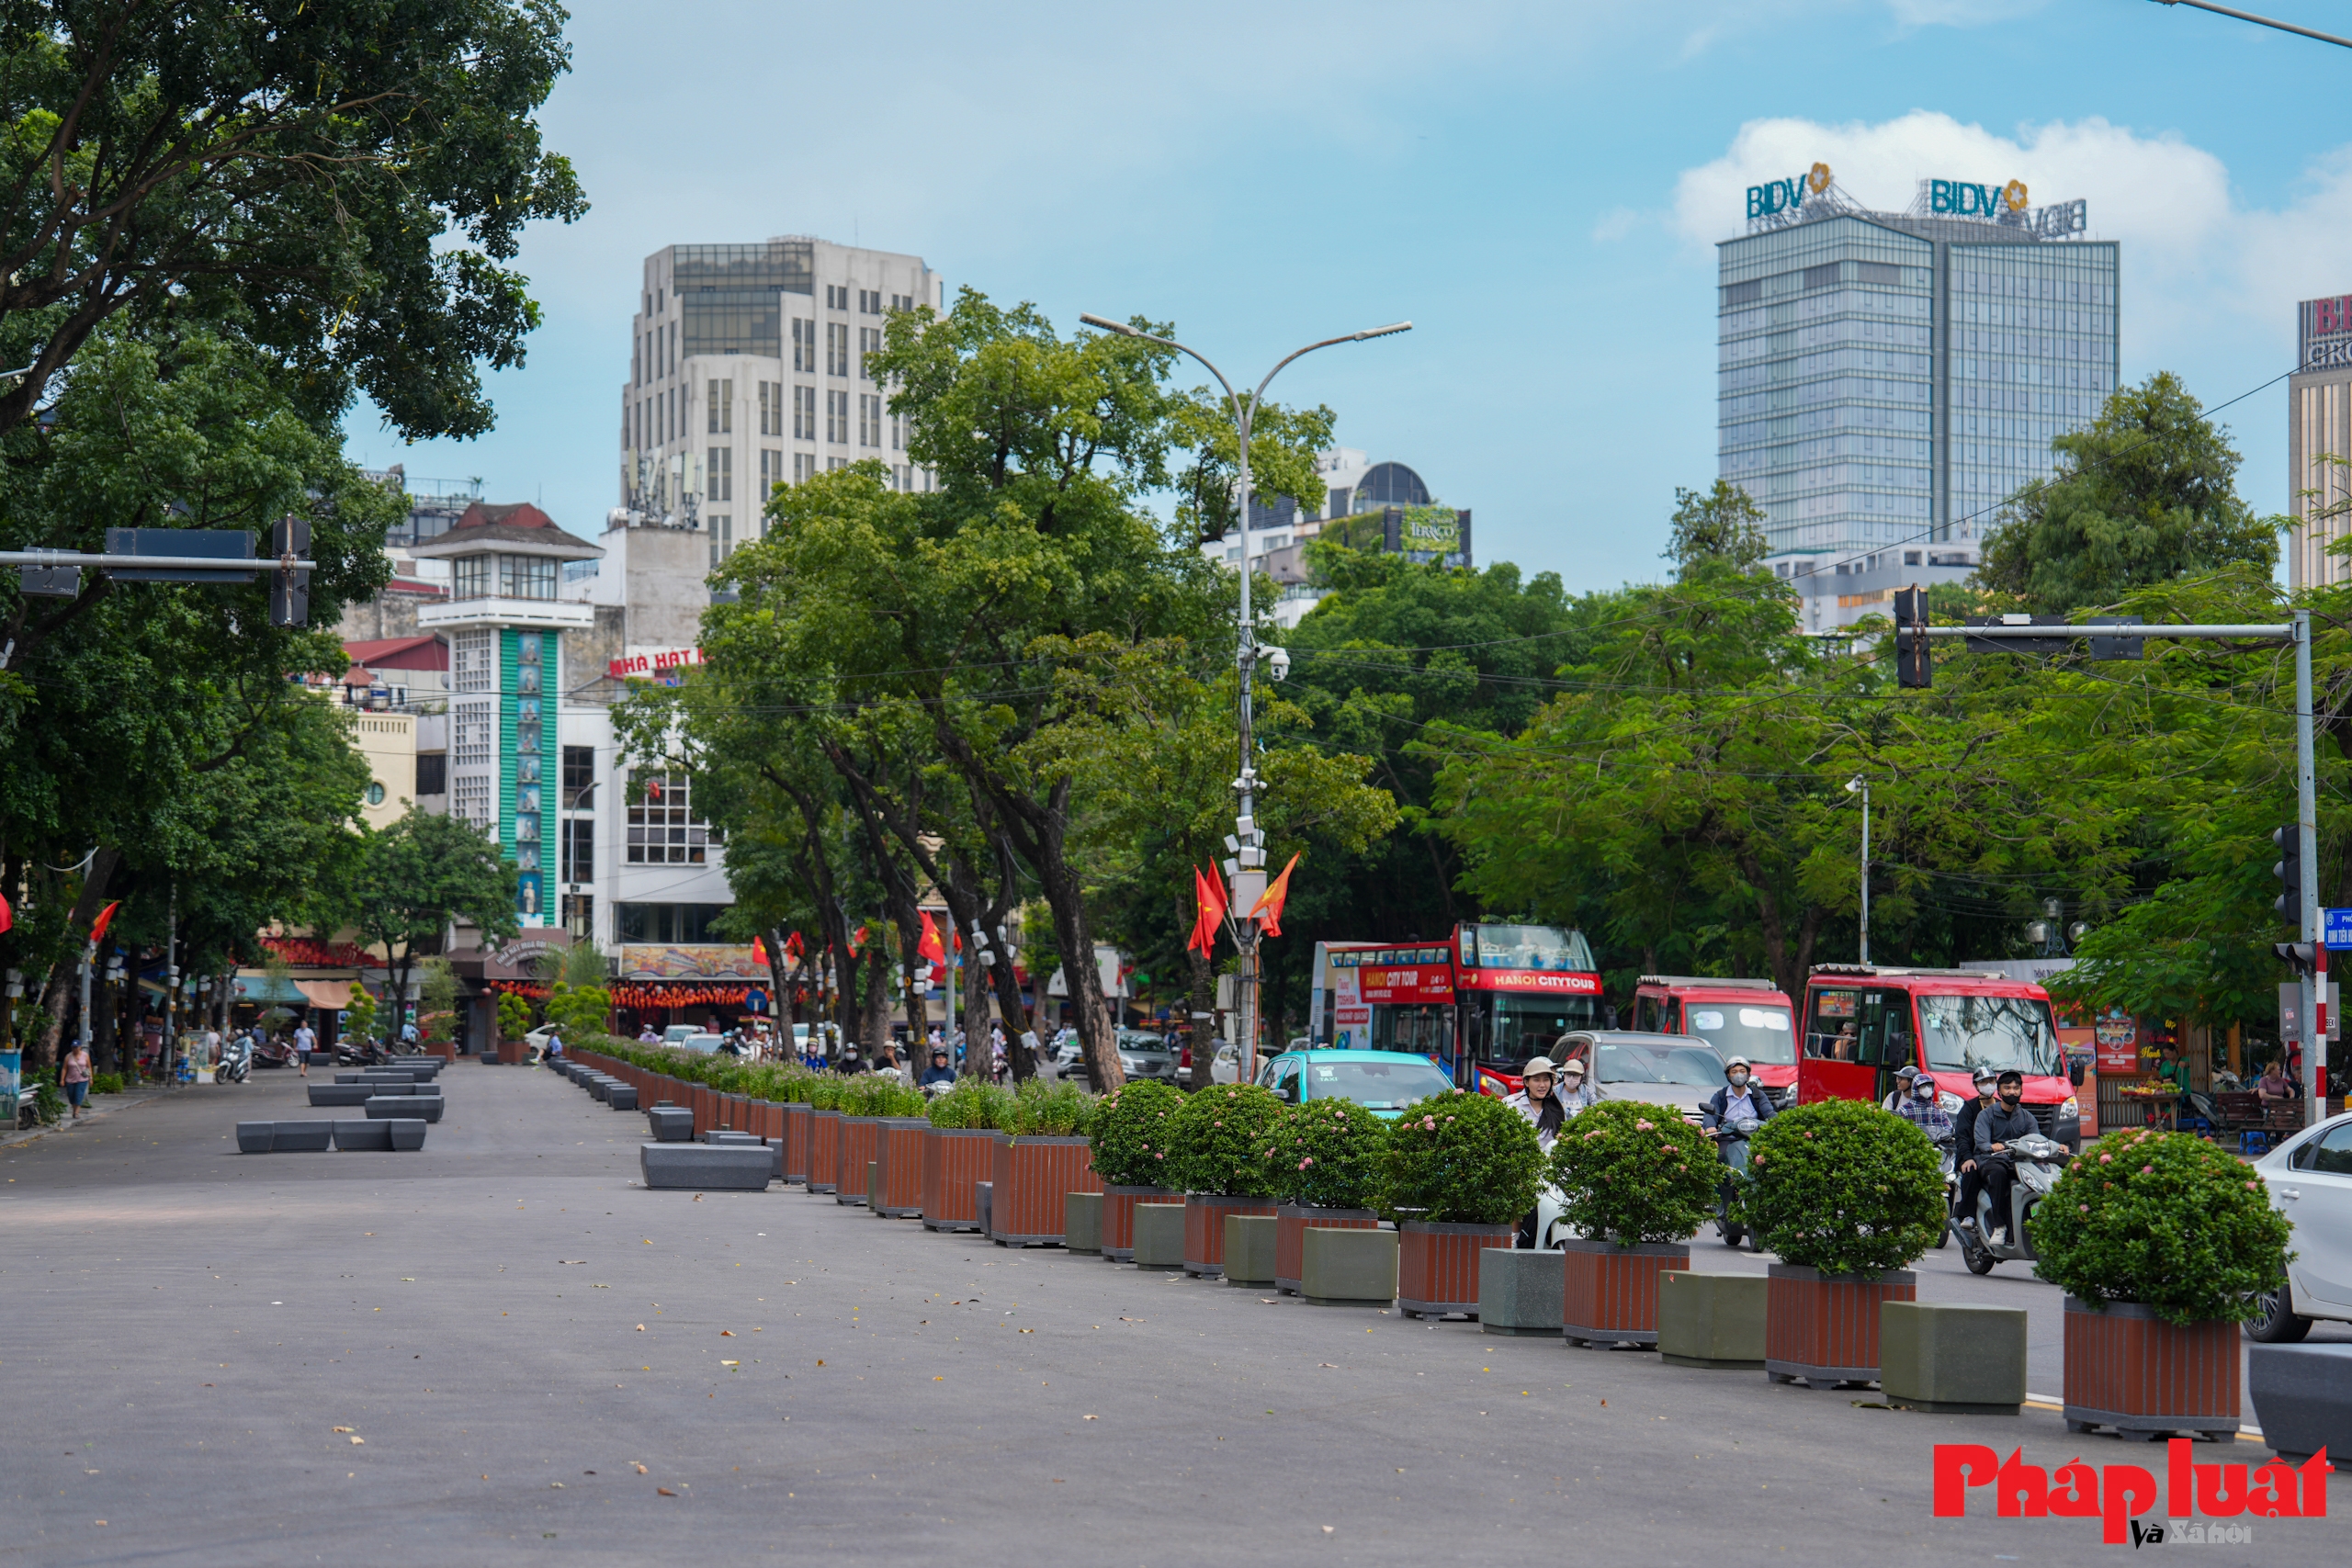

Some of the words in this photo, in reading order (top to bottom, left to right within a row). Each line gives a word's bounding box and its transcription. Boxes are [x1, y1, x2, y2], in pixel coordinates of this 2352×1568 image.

[1747, 173, 1807, 220] BIDV
[1931, 179, 2002, 217] BIDV
[609, 652, 649, 676] NHÀ
[655, 647, 690, 669] HÁT
[1365, 972, 1386, 987] HANOI
[1386, 971, 1401, 987] CITY
[1401, 970, 1418, 987] TOUR
[1495, 976, 1536, 986] HANOI
